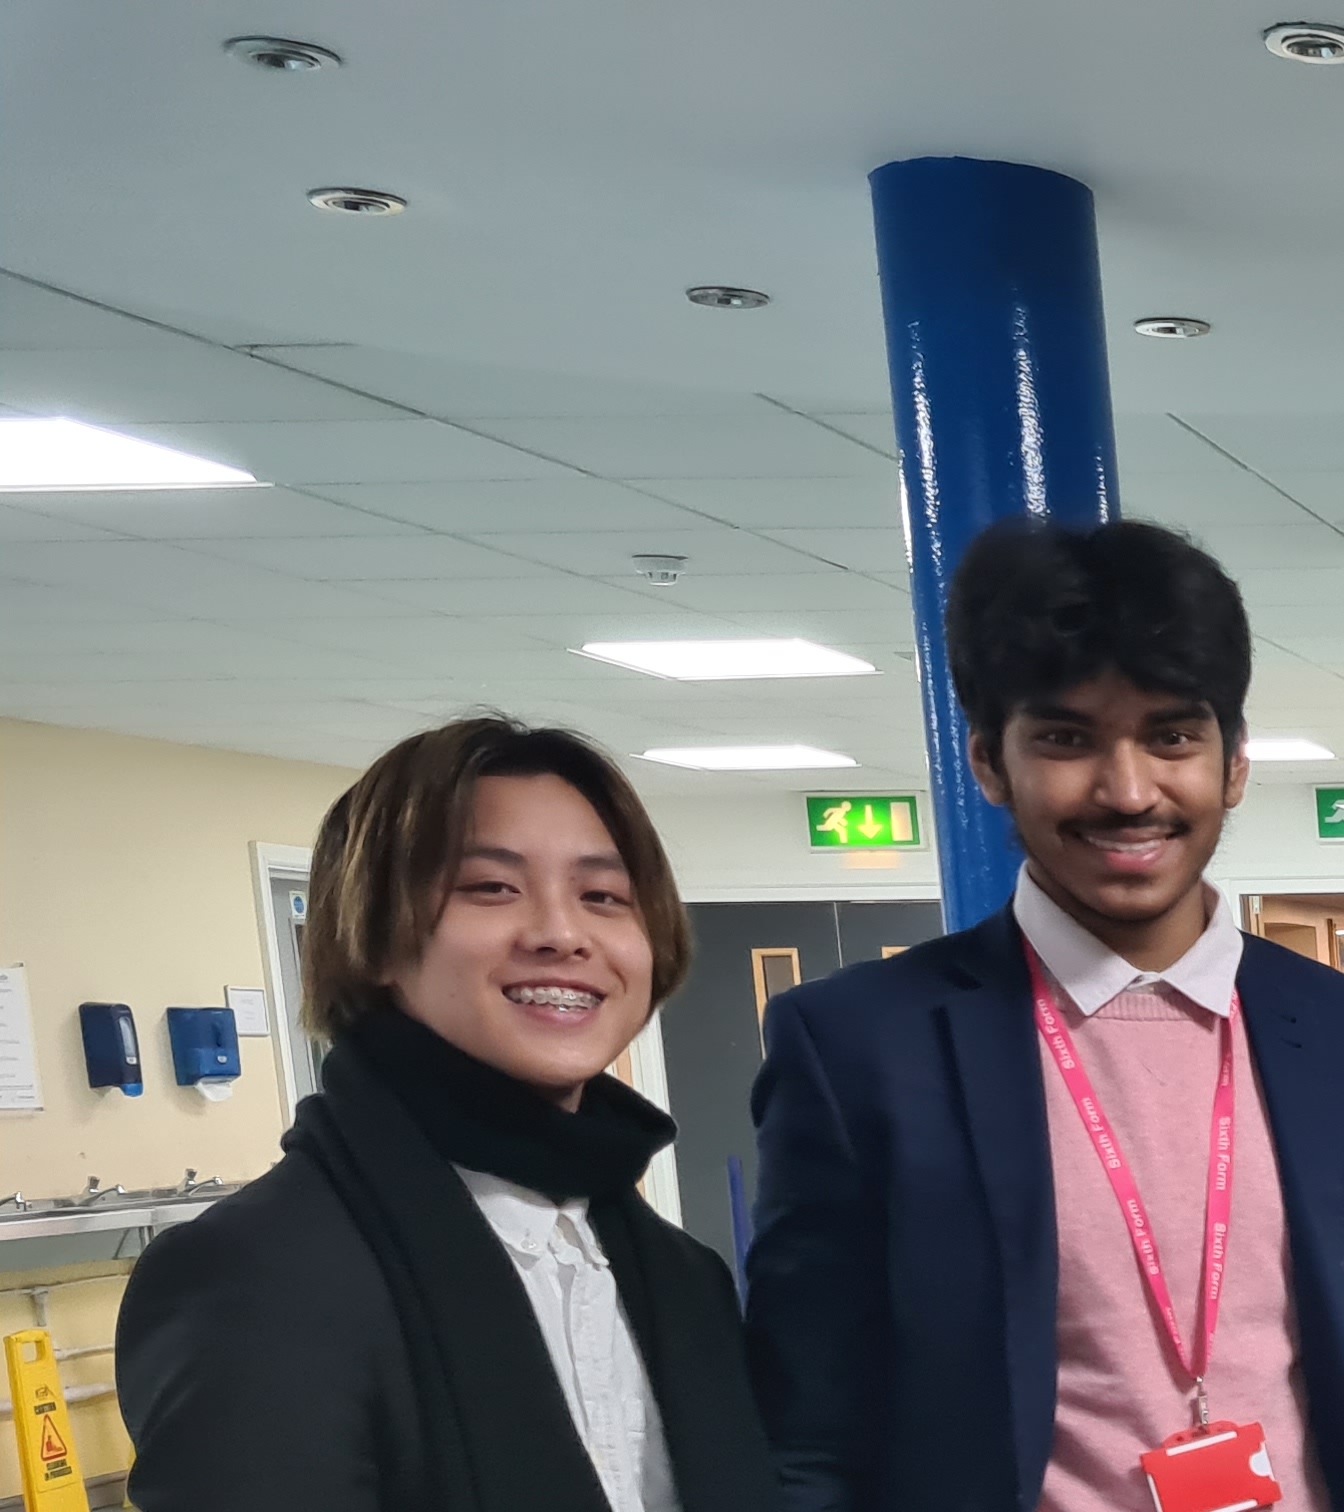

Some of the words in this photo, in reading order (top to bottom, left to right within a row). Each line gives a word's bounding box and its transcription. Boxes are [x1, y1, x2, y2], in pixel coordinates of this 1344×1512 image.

[1217, 1116, 1231, 1150] Sixth
[1215, 1153, 1231, 1191] Form
[1210, 1262, 1224, 1300] Form
